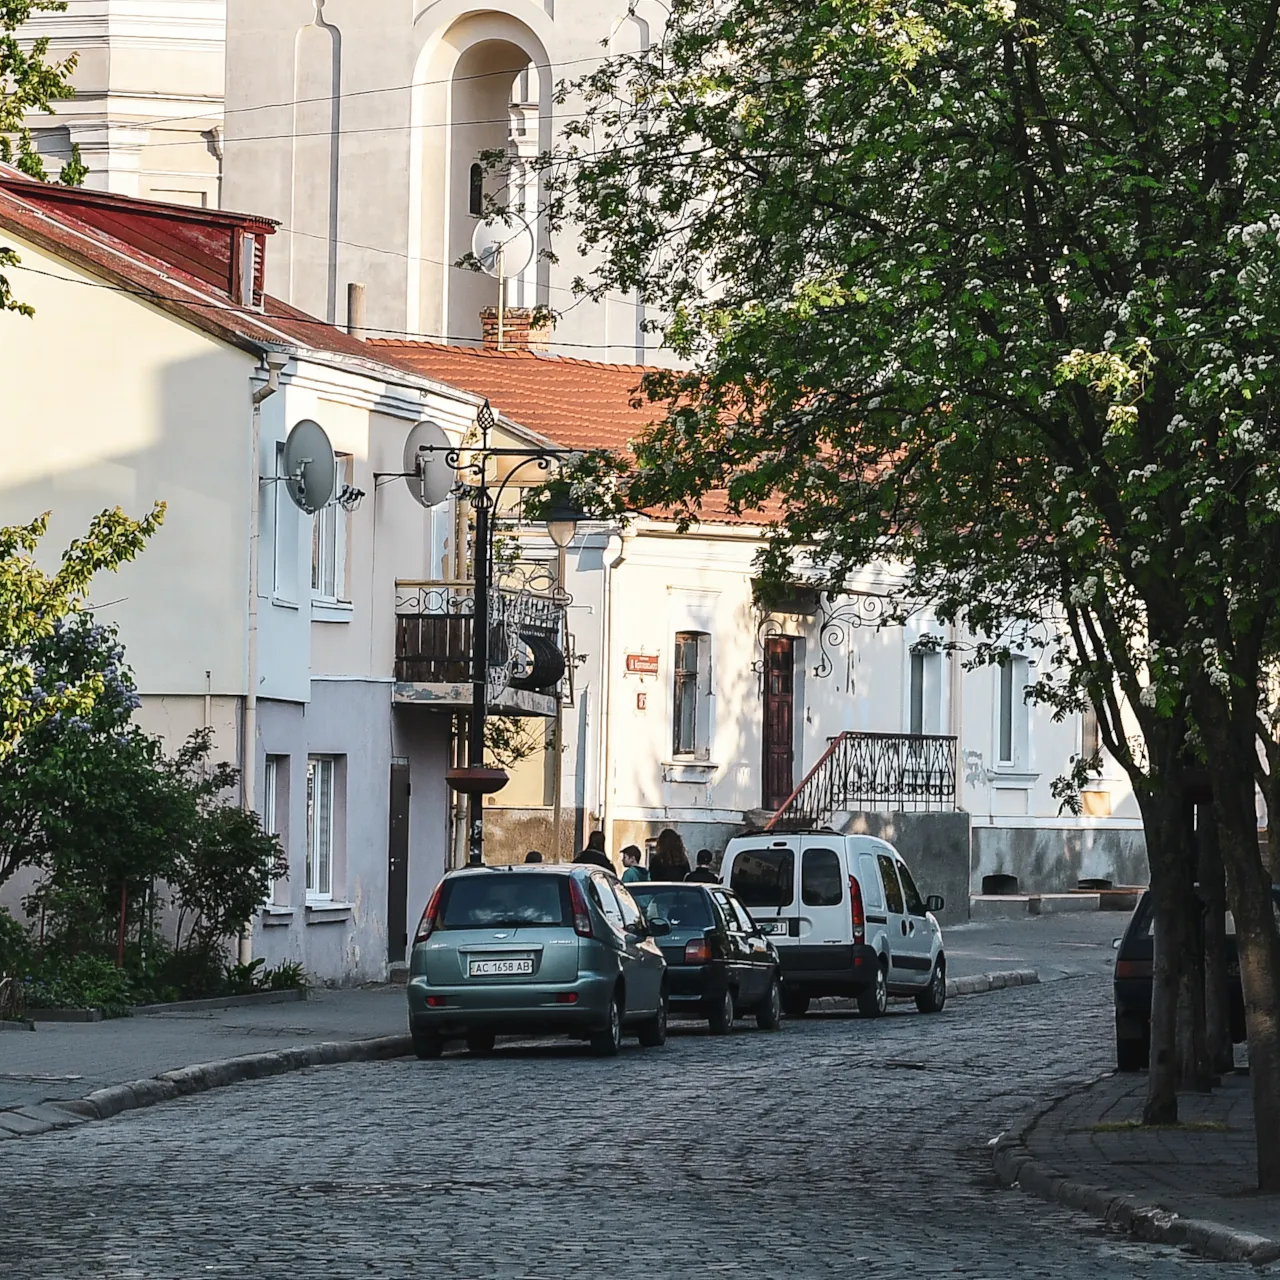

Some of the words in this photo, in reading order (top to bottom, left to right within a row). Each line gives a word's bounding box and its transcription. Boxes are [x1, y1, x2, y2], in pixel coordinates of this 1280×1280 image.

[476, 963, 489, 973] AC
[492, 962, 514, 972] 1658
[517, 961, 530, 971] AB
